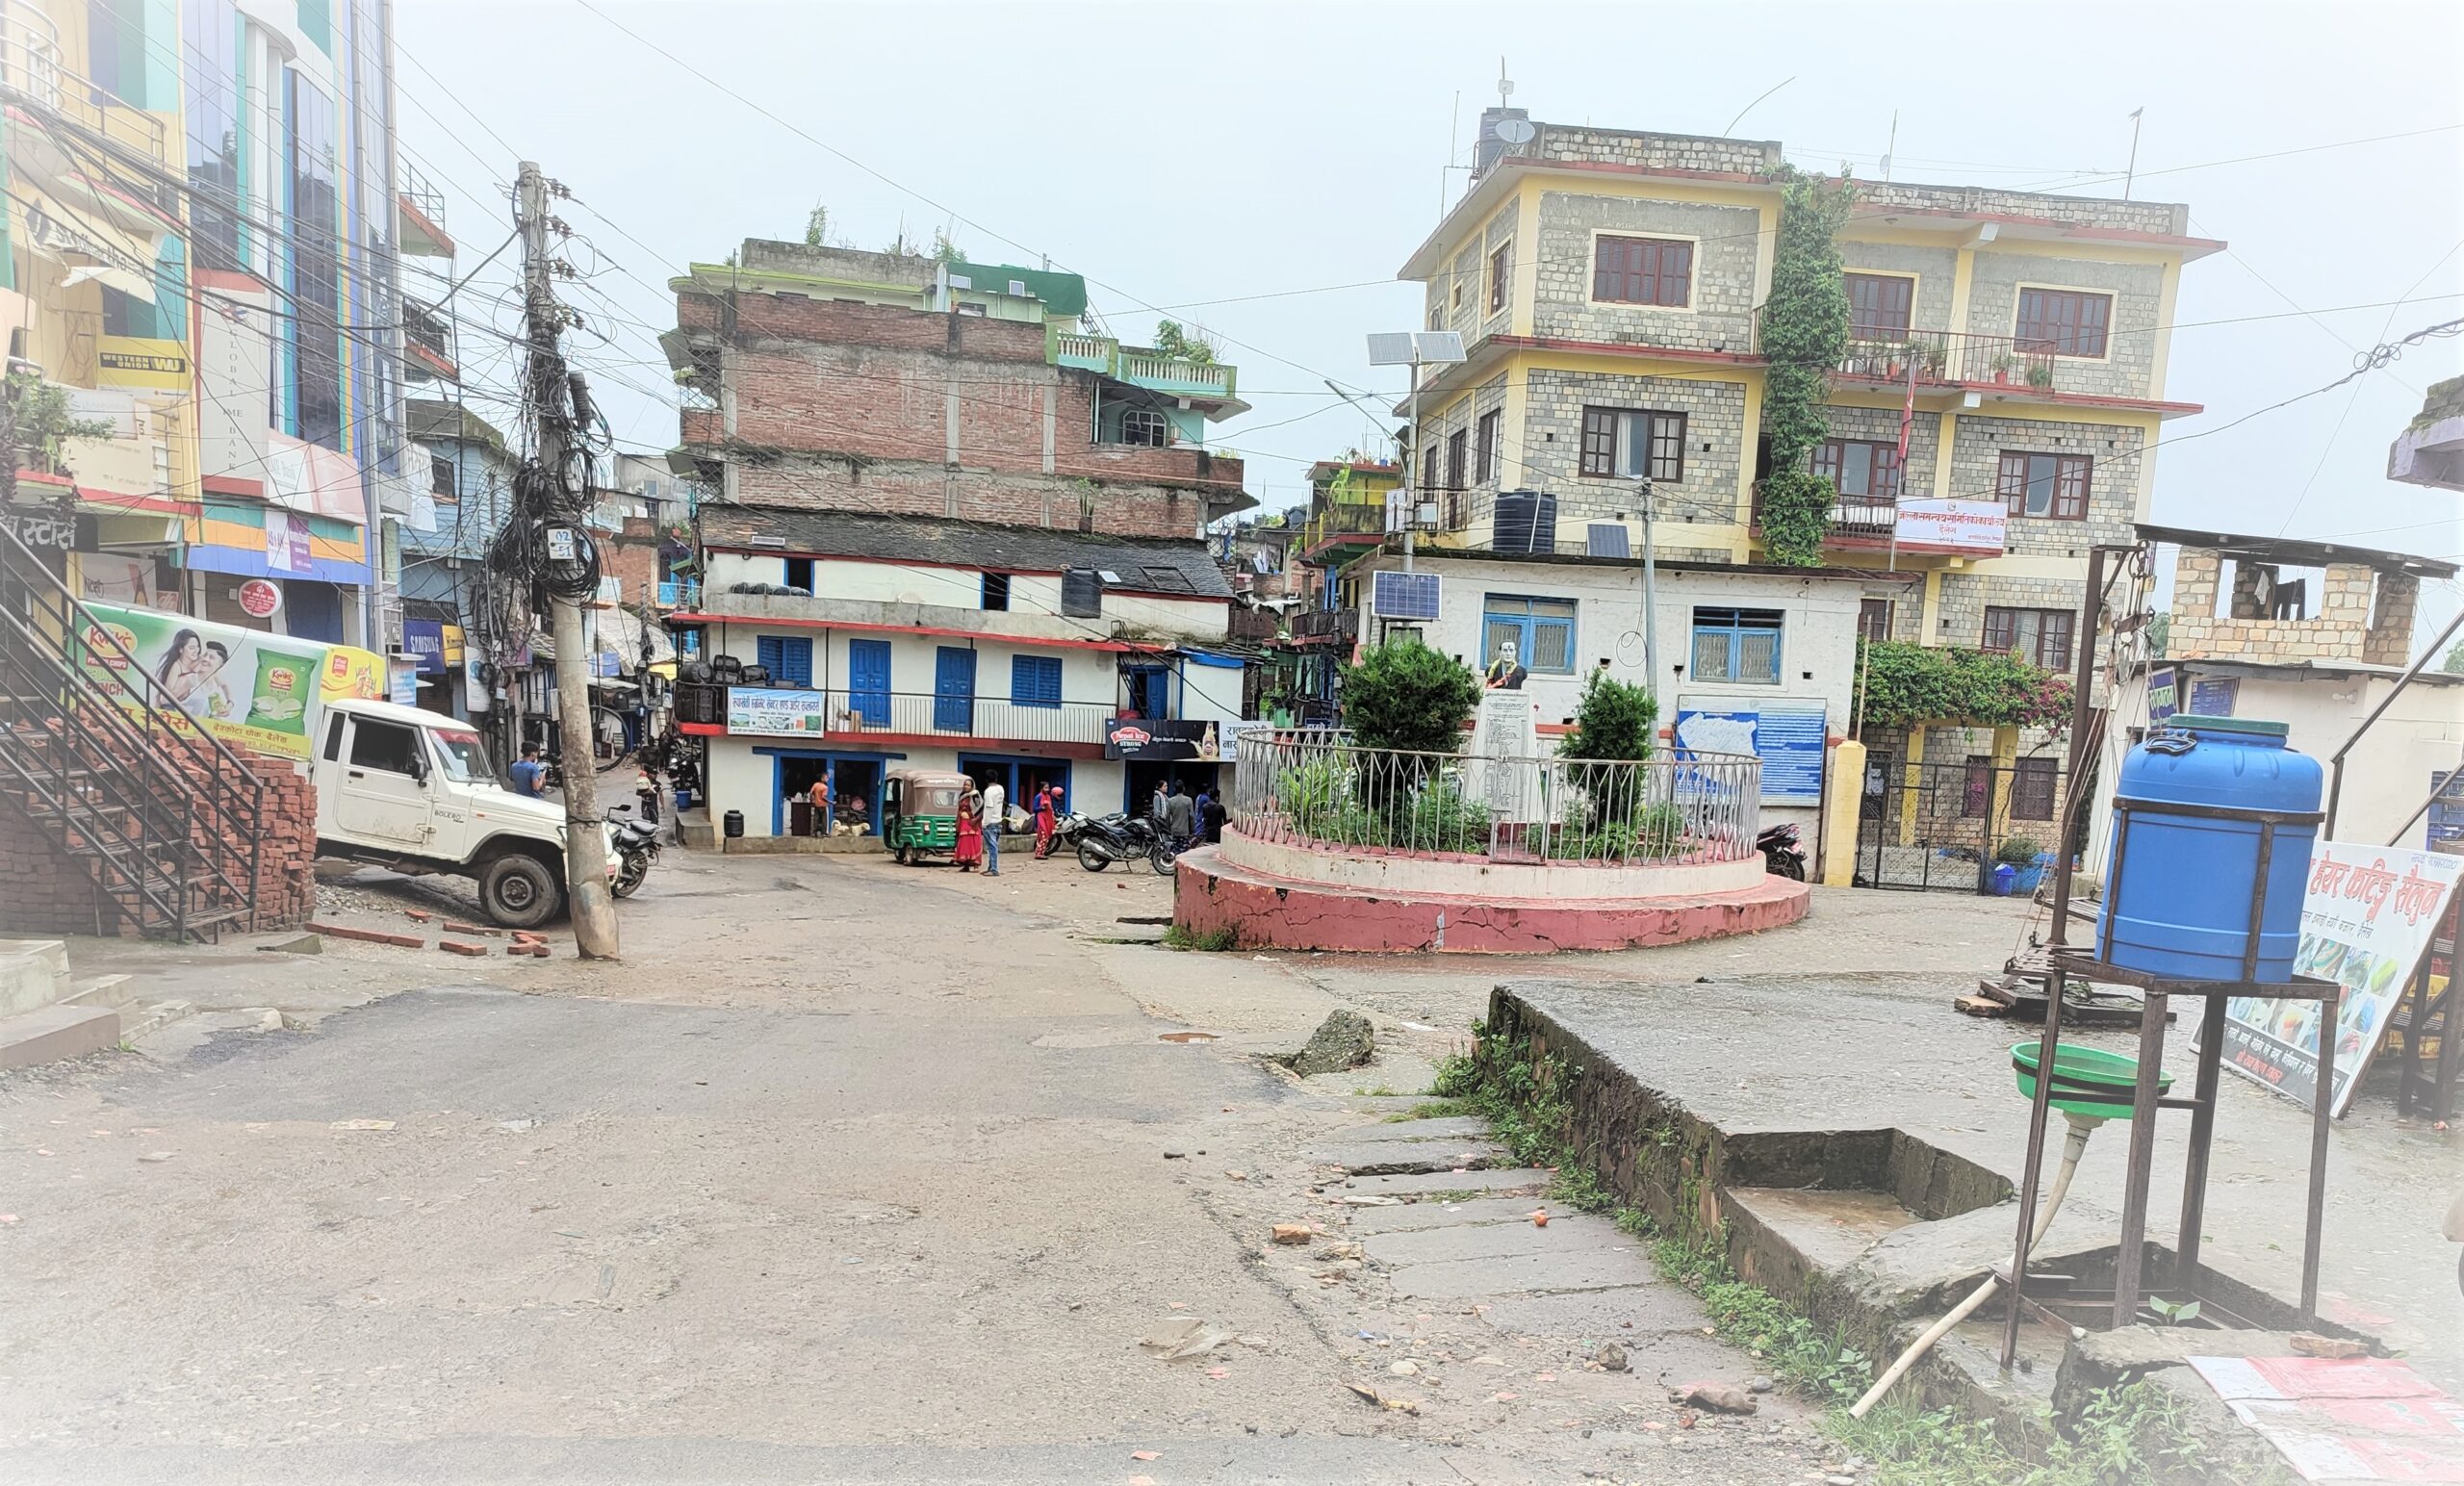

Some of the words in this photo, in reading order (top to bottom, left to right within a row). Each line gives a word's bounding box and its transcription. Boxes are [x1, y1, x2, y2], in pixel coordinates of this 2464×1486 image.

[102, 354, 148, 363] WESTERN
[154, 358, 180, 372] WU
[117, 361, 149, 370] UNION
[89, 627, 132, 651] Kwk's
[410, 634, 440, 653] SAMSUNG
[434, 810, 461, 820] BOLERO
